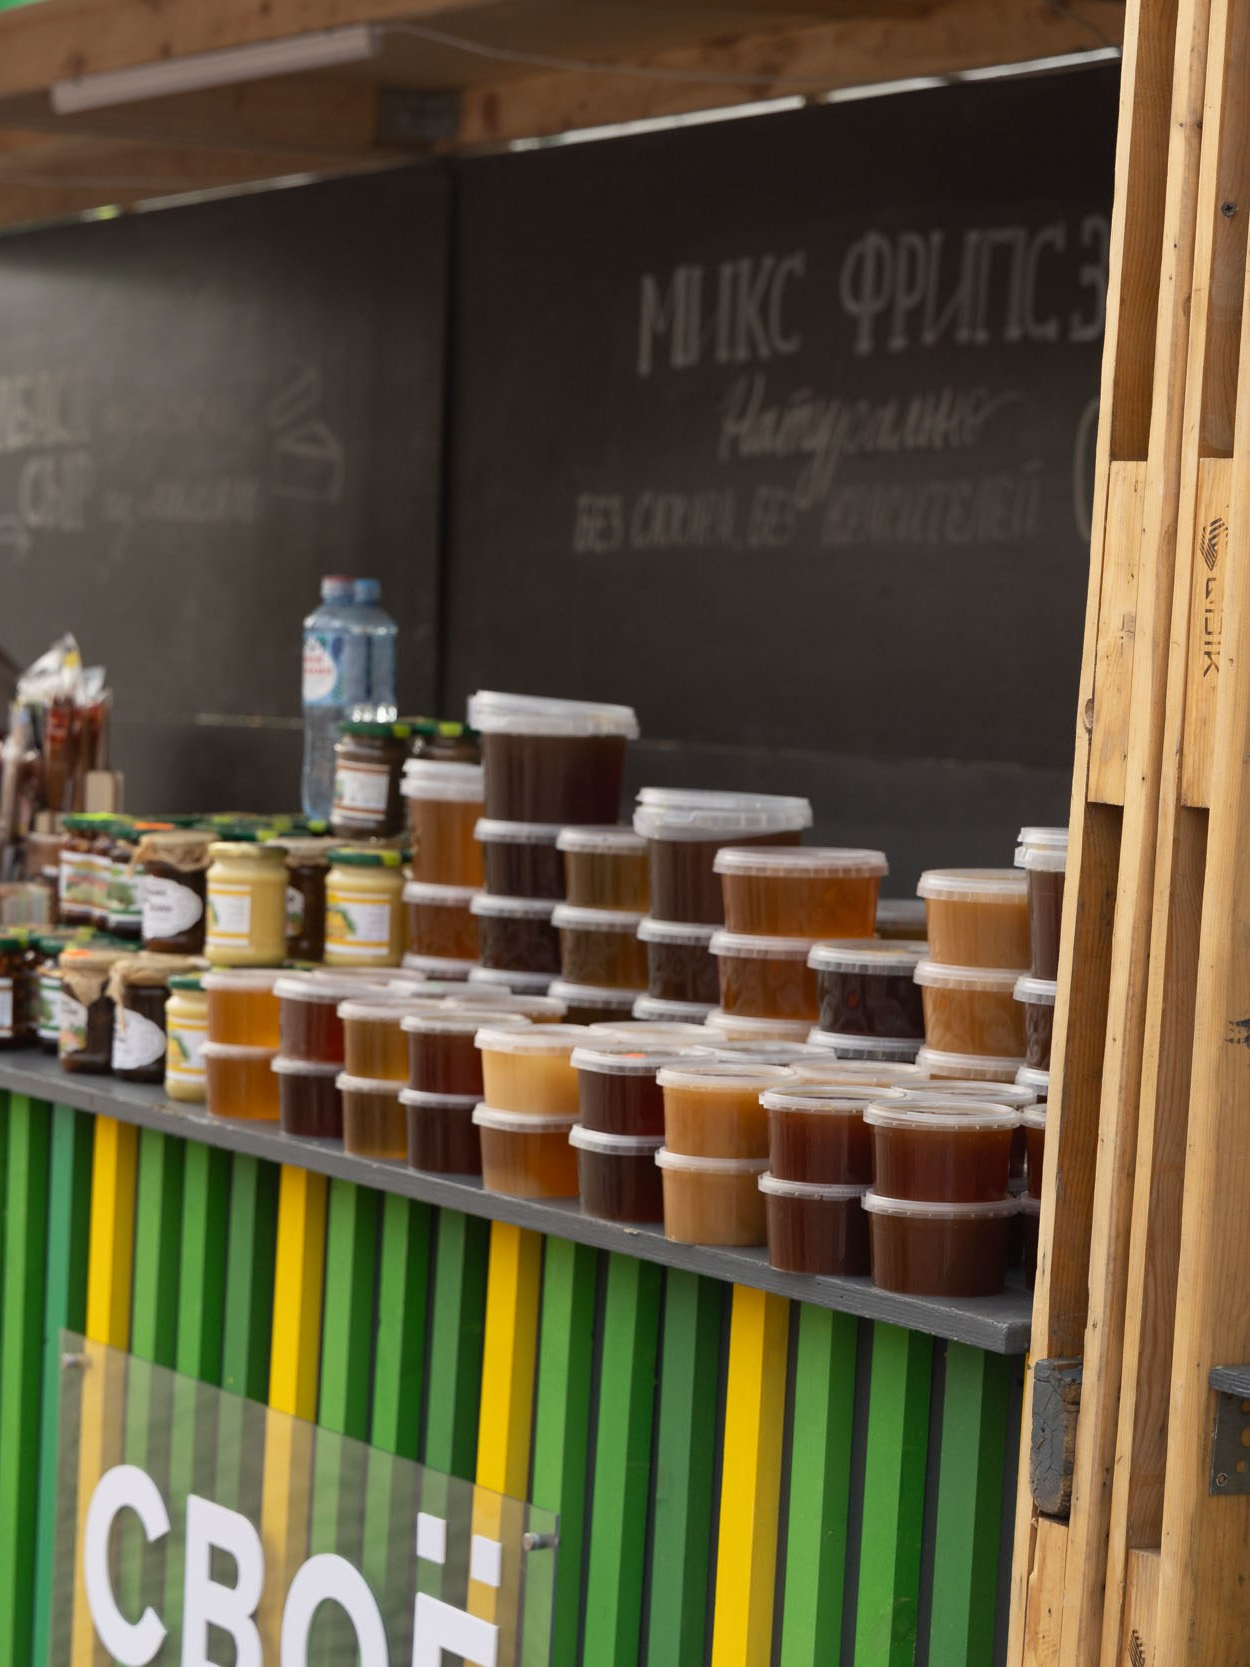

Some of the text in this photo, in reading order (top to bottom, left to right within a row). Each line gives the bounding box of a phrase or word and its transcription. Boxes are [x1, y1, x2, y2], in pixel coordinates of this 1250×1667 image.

[636, 247, 808, 380] МИКС
[838, 220, 1067, 357] ФРИПС
[84, 1464, 503, 1667] СВОЁ
